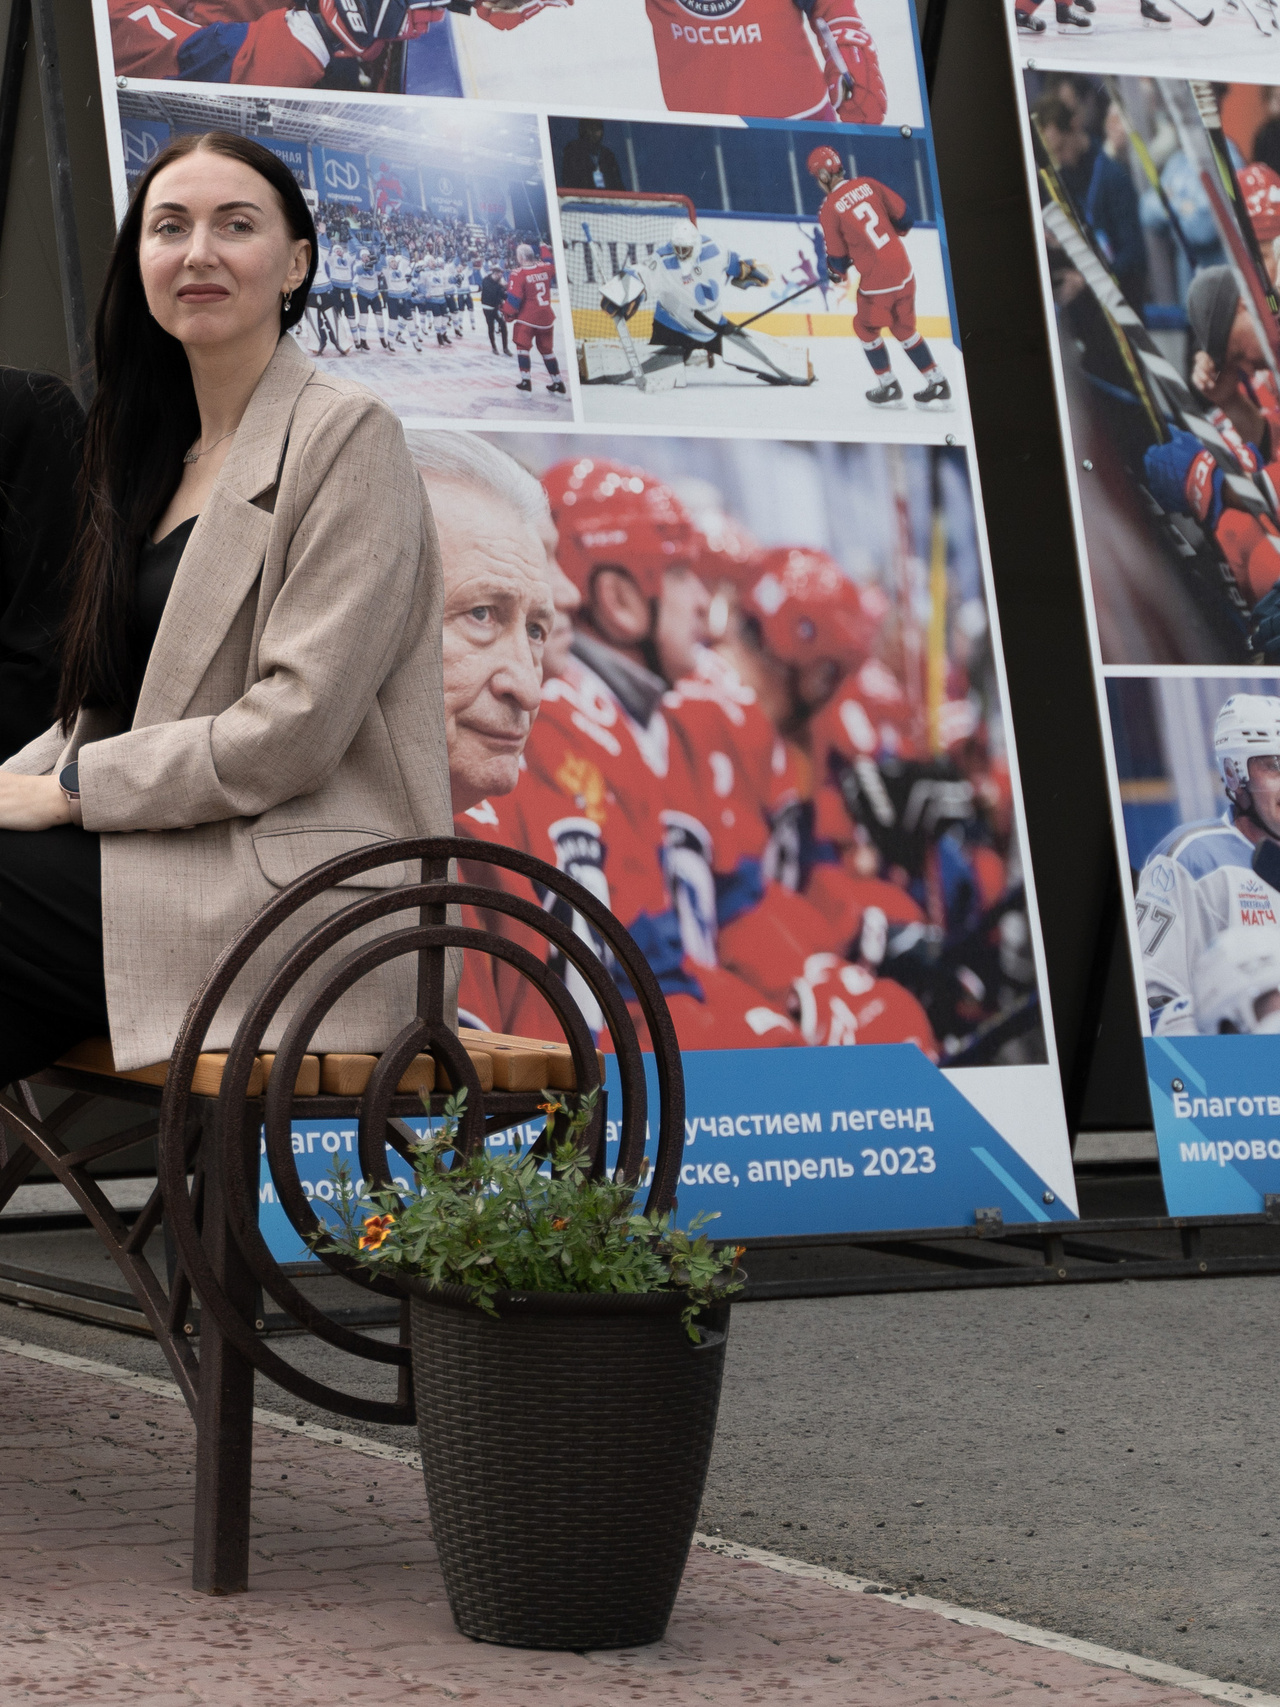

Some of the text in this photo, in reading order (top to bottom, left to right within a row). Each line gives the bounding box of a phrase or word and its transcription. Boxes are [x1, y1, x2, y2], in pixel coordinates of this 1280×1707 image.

[670, 22, 763, 45] РОССИЯ
[852, 201, 891, 250] 2
[535, 281, 550, 306] 2
[1240, 909, 1277, 926] МАТЧ
[1173, 1092, 1280, 1118] Благотв
[685, 1111, 822, 1145] участием
[831, 1106, 935, 1133] легенд
[748, 1153, 855, 1188] апрель
[861, 1145, 937, 1177] 2023
[1179, 1139, 1280, 1168] мирово
